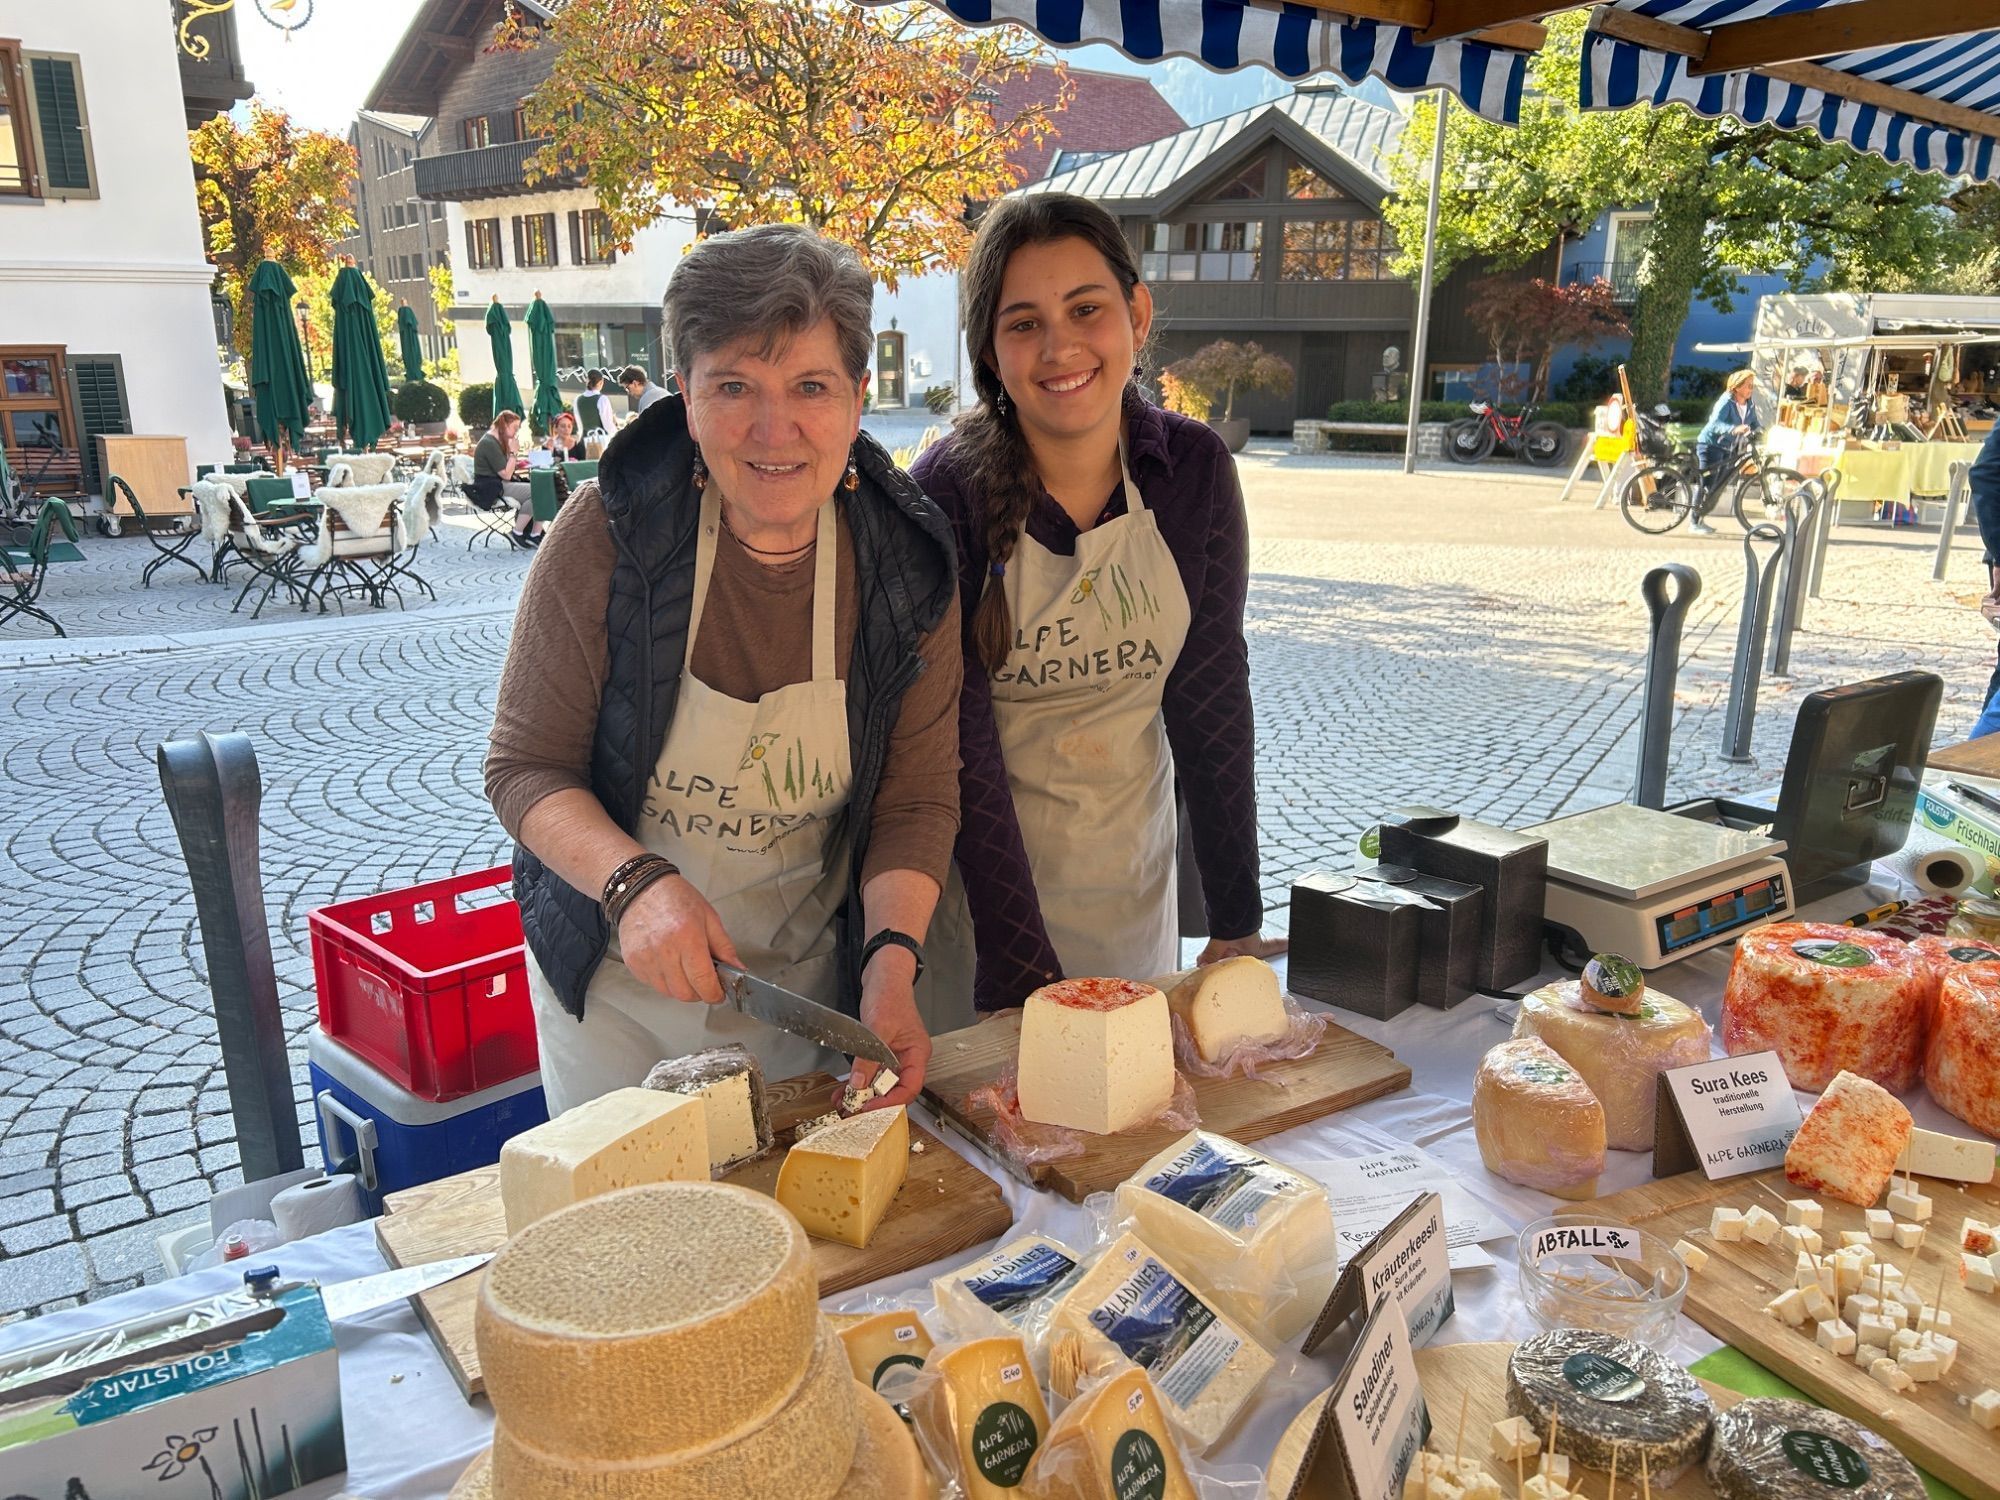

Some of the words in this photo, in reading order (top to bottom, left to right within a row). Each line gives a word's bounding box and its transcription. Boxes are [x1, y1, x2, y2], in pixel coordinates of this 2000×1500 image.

[1015, 617, 1080, 652] LPE
[992, 639, 1162, 688] GARNERA
[1925, 800, 1950, 819] FOLISTAR
[1691, 1077, 1730, 1095] Sura
[1729, 1070, 1768, 1088] Kees
[1713, 1088, 1760, 1105] traditionelle
[1719, 1101, 1765, 1117] Herstellung
[1707, 1148, 1735, 1165] ALPE
[1736, 1138, 1787, 1160] GARNERA
[1359, 1160, 1389, 1173] ALPE
[1367, 1163, 1422, 1179] GARNERA
[1371, 1214, 1438, 1294] Kräuterkeesli
[1536, 1227, 1606, 1258] ABFALL
[964, 1245, 1051, 1291] SALADINER
[1013, 1254, 1062, 1282] Montafoner
[1394, 1270, 1409, 1289] Sura
[1407, 1256, 1423, 1276] Kees
[1403, 1267, 1428, 1297] Kräutern
[1094, 1263, 1165, 1332] SALADINER
[1139, 1279, 1178, 1317] Montafoner
[1186, 1302, 1204, 1319] Alpe
[1188, 1312, 1213, 1336] Garnera
[101, 1349, 231, 1399] FOLISTAR
[1003, 1367, 1021, 1380] 5,40
[1352, 1332, 1394, 1422] Saladiner
[1576, 1371, 1601, 1387] ALPE
[1590, 1371, 1634, 1397] GARNERA
[1371, 1427, 1381, 1446] aus
[1378, 1382, 1399, 1429] Rohmilch
[979, 1430, 1005, 1453] ALPE
[984, 1436, 1032, 1469] GARNERA
[1116, 1460, 1137, 1487] ALPE
[1388, 1431, 1416, 1497] GARNERA
[1809, 1454, 1832, 1480] ALPE
[1820, 1439, 1850, 1484] GARNERA
